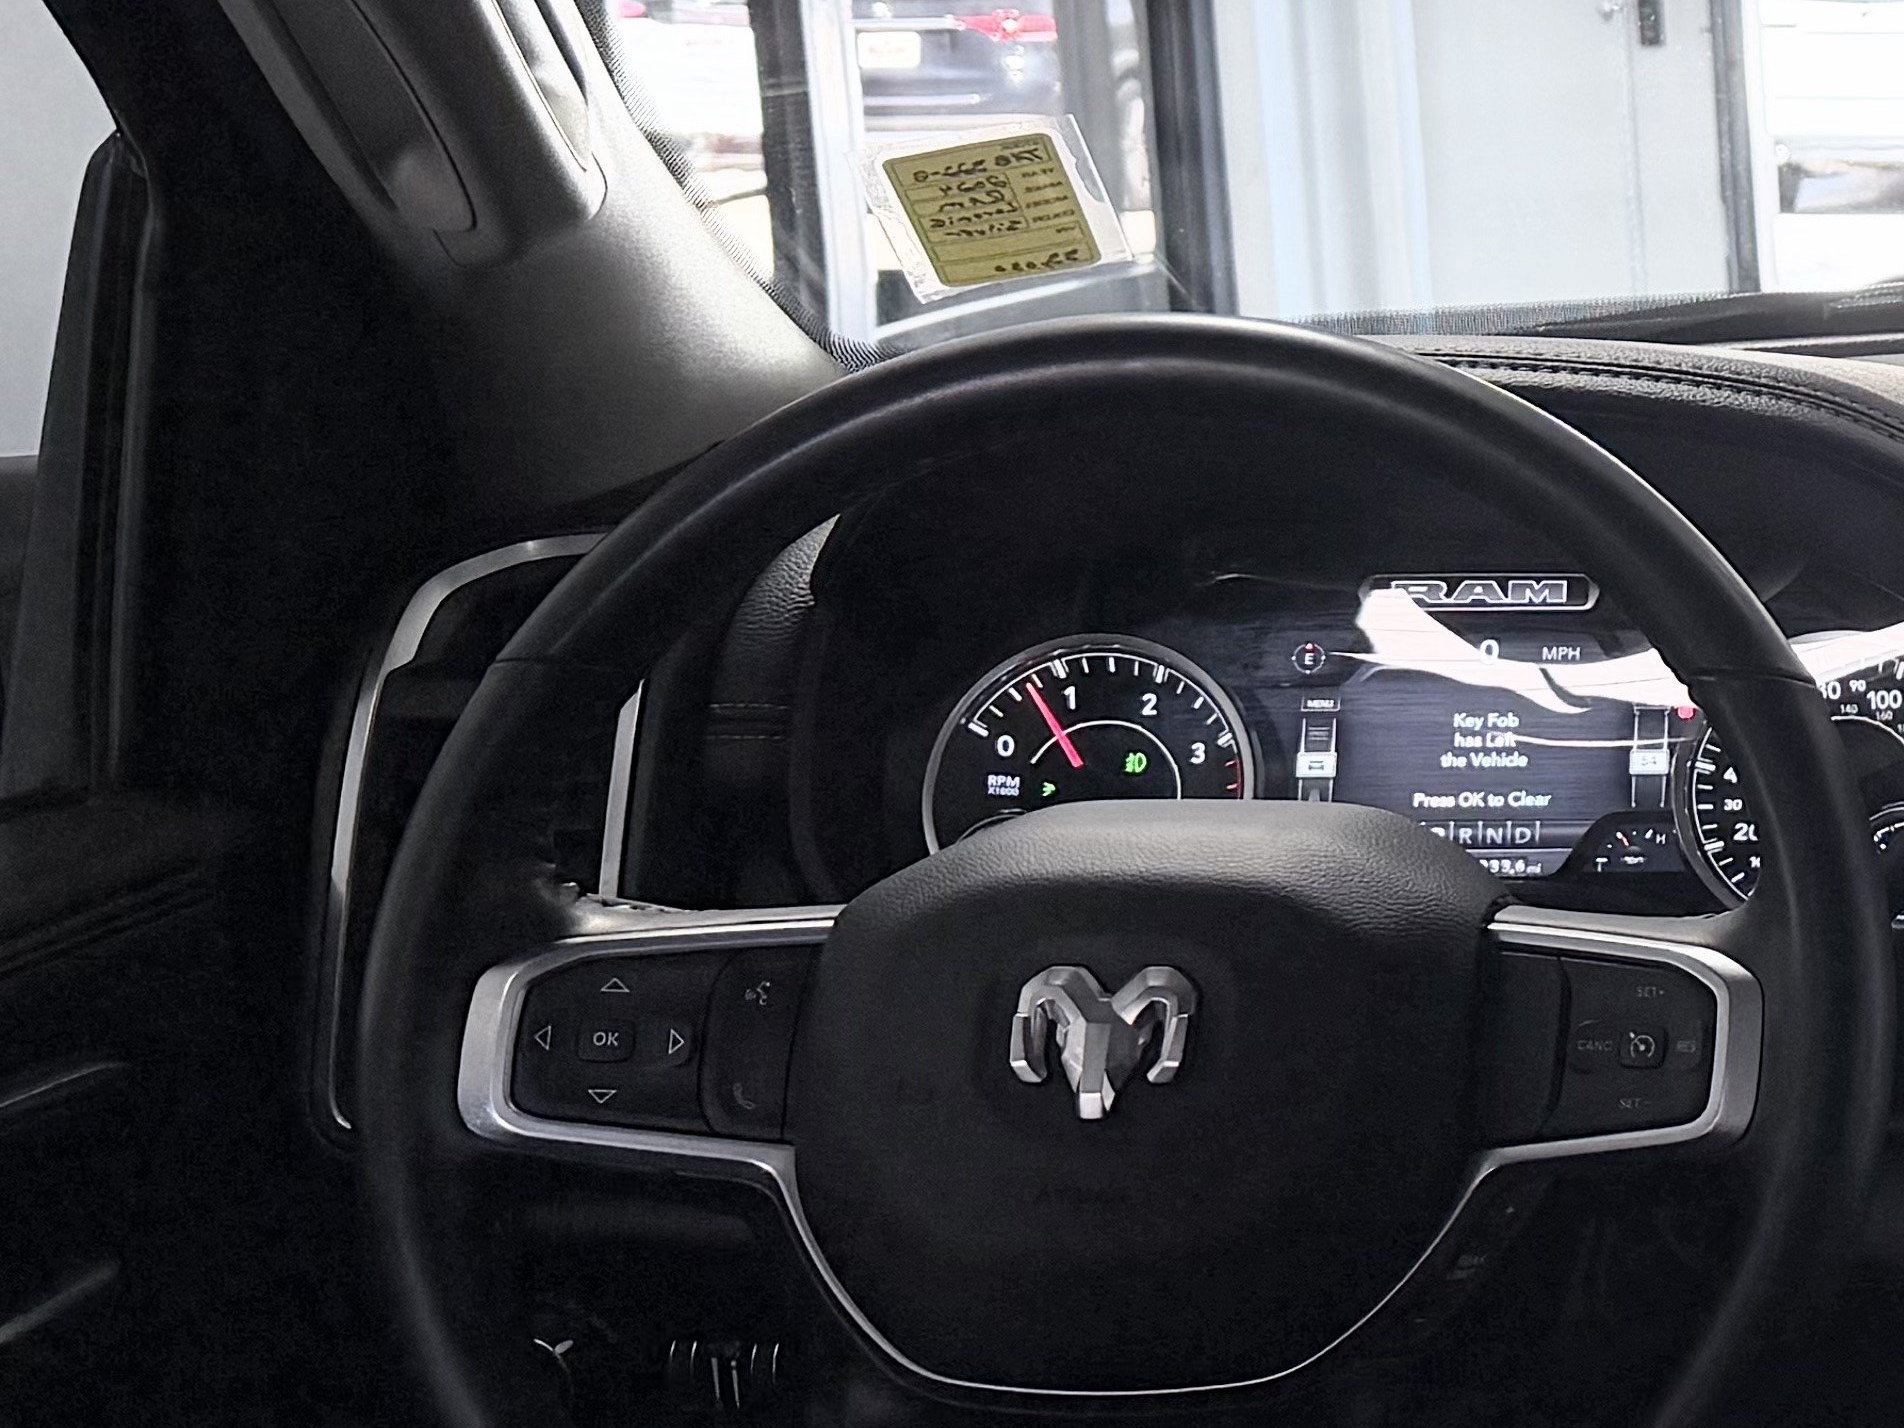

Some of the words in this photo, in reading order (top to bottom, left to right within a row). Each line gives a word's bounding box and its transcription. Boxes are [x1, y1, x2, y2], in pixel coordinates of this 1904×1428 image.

[1391, 580, 1568, 604] RAM
[1303, 652, 1315, 666] E
[1479, 639, 1500, 665] 0
[1541, 646, 1582, 661] MPH
[1849, 679, 1867, 693] 90
[1063, 685, 1077, 710] 1
[1140, 692, 1158, 716] 2
[1866, 690, 1903, 710] 100
[1453, 712, 1484, 732] Key
[1487, 712, 1521, 729] Fob
[996, 734, 1015, 758] 0
[1453, 731, 1483, 748] has
[1485, 731, 1517, 748] Left
[1190, 742, 1207, 766] 3
[1440, 751, 1468, 768] the
[1469, 751, 1530, 768] Vehicle
[987, 775, 1021, 789] RPM
[1412, 791, 1456, 808] Press
[1458, 790, 1486, 807] OK
[1487, 791, 1506, 807] to
[1507, 789, 1553, 808] Clear
[1723, 799, 1743, 812] 30
[1459, 827, 1474, 845] R
[1486, 827, 1504, 845] N
[1514, 826, 1533, 844] D
[1656, 833, 1667, 846] H
[1526, 861, 1543, 873] mi
[592, 1031, 620, 1048] OK
